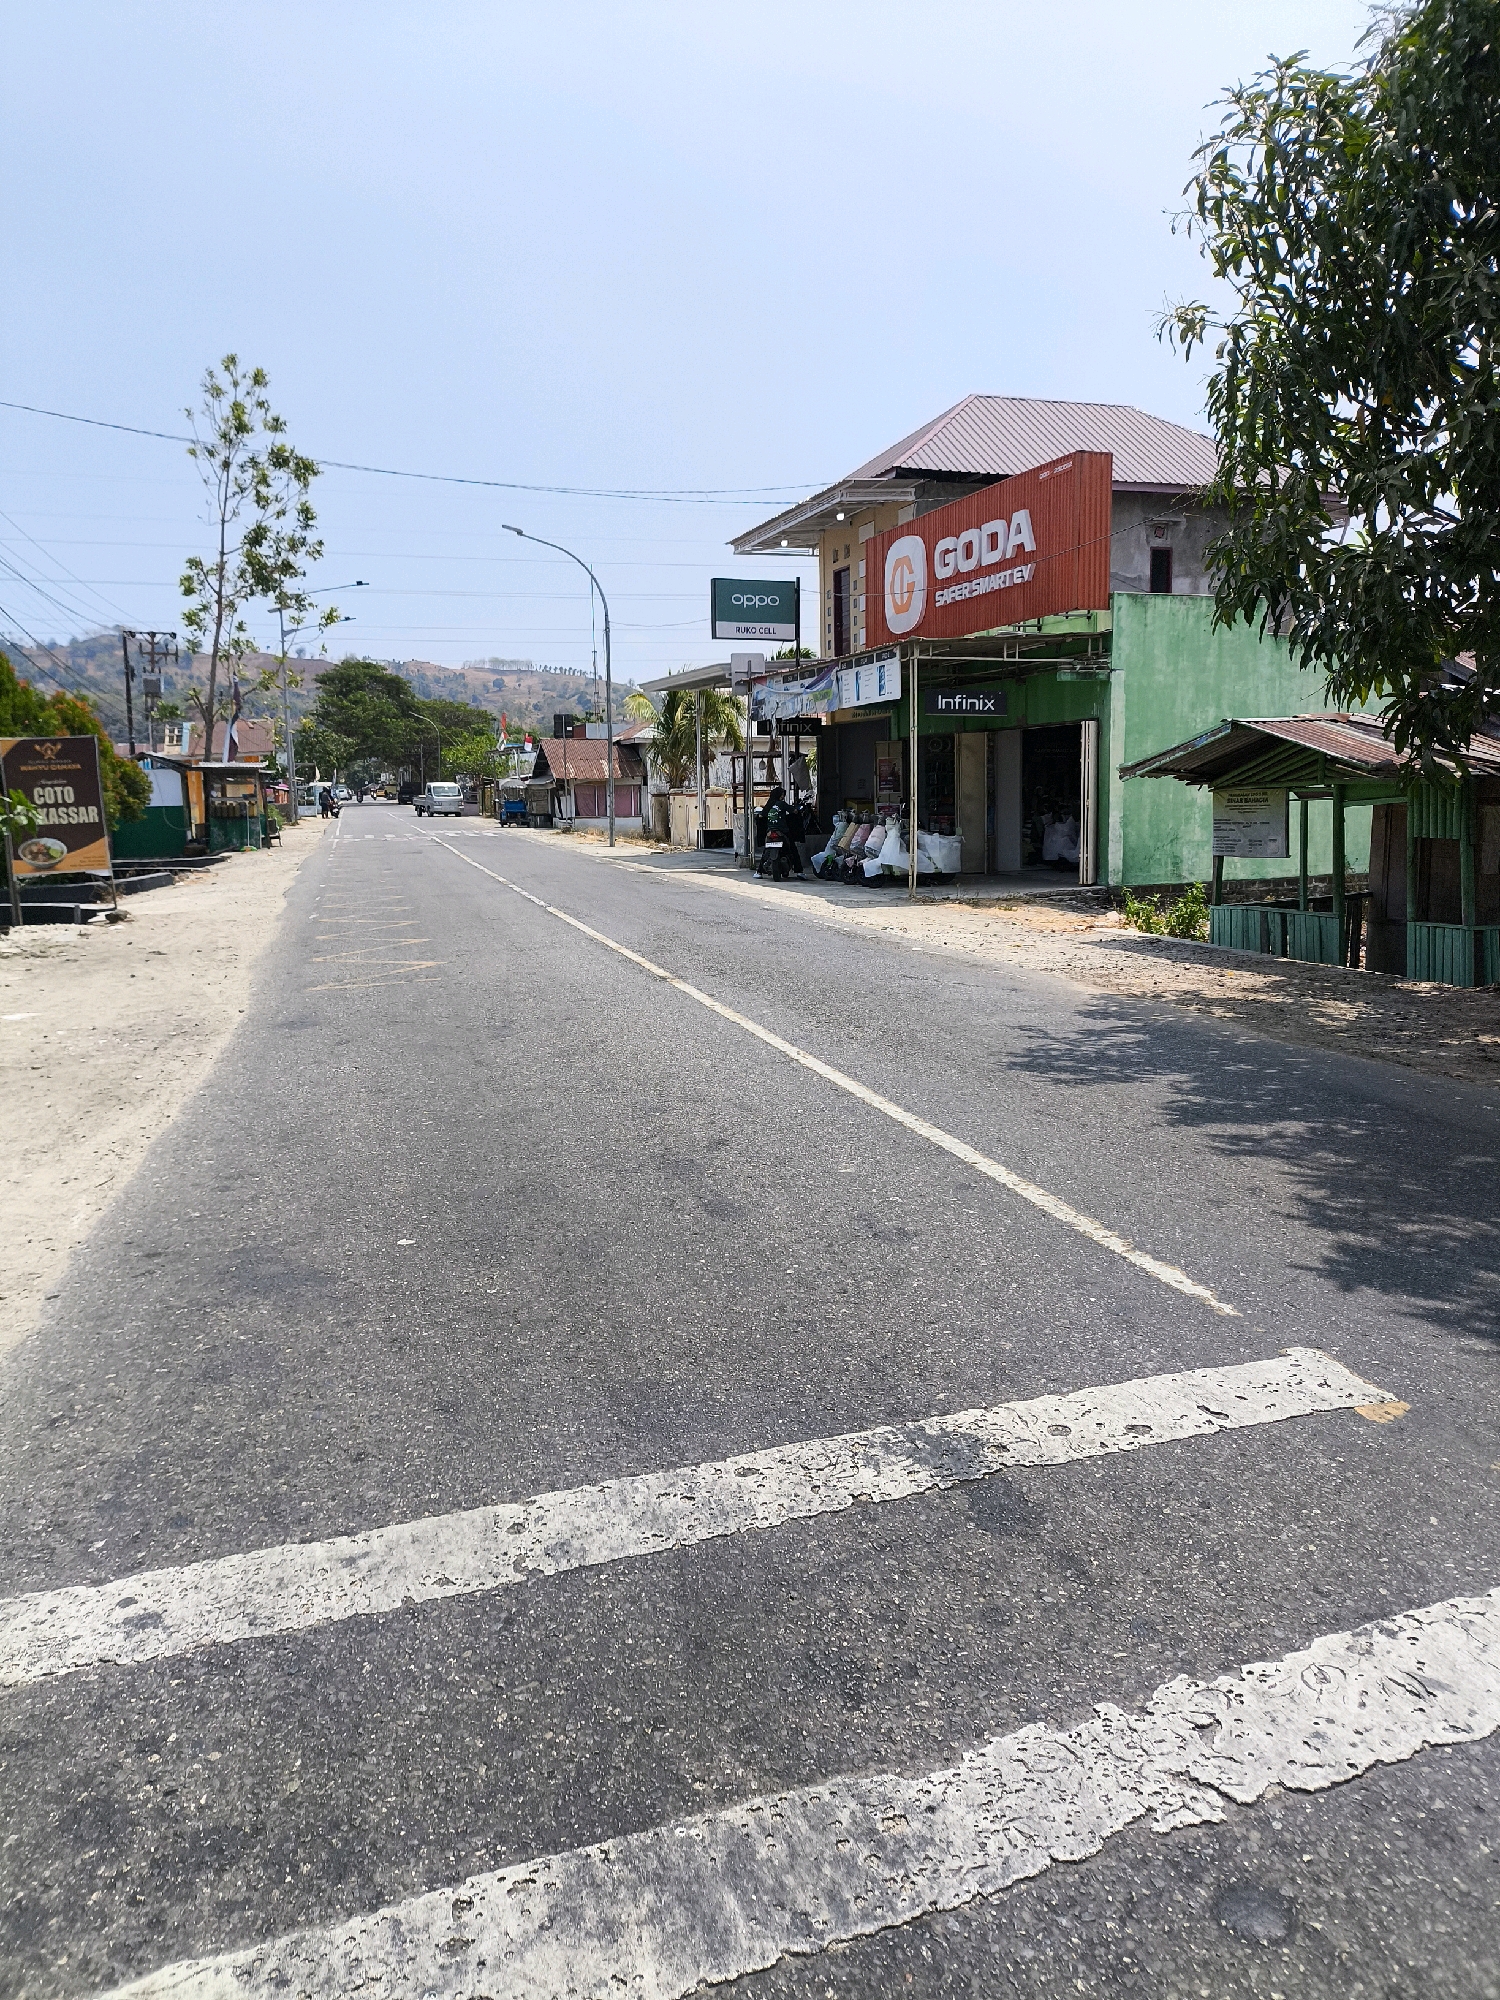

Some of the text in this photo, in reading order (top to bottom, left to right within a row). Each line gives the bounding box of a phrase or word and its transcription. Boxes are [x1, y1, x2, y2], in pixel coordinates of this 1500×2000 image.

[934, 509, 1036, 579] GODA
[935, 563, 1036, 607] SAFER SMART EV
[731, 593, 780, 608] oppo
[735, 626, 777, 635] RUKO CELL
[937, 694, 995, 711] Infinix
[33, 786, 75, 805] COTO
